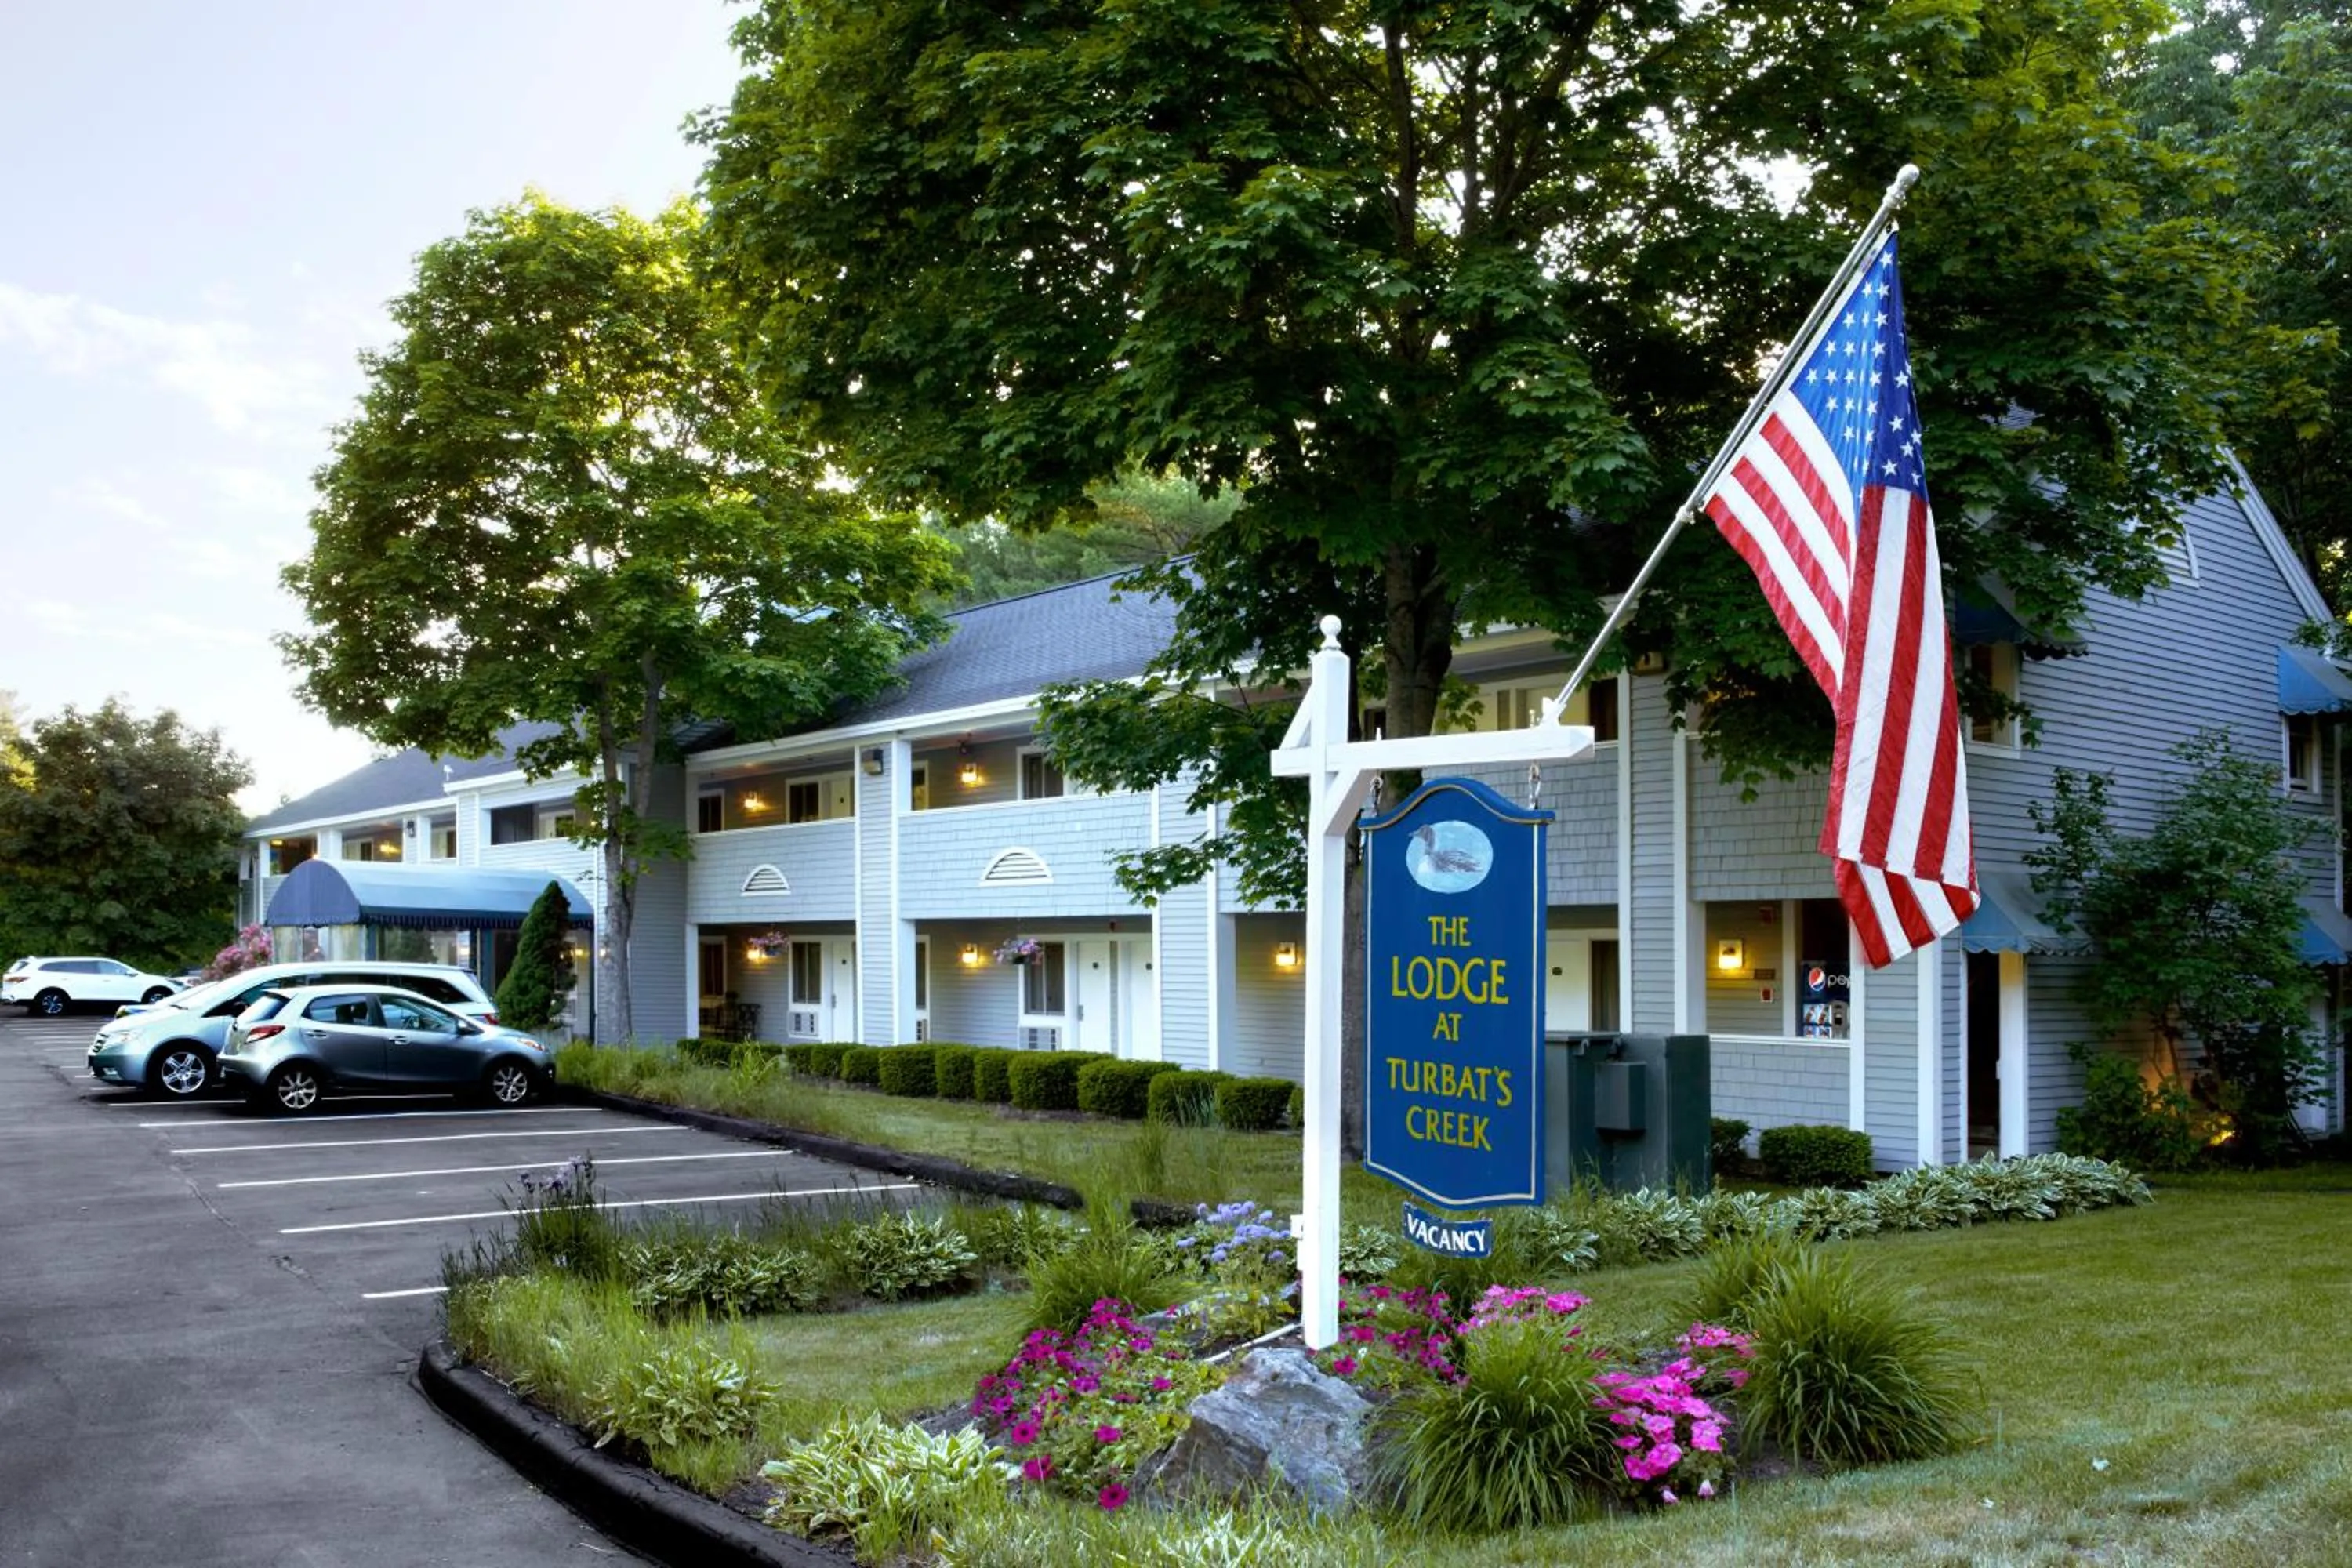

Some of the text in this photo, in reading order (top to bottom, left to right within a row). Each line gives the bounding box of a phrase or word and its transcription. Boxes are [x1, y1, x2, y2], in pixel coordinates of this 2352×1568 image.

[1428, 916, 1471, 946] THE
[1392, 956, 1509, 1004] LODGE
[1432, 1012, 1462, 1041] AT
[1386, 1057, 1512, 1106] TURBAT'S
[1406, 1105, 1492, 1152] CREEK
[1407, 1213, 1485, 1252] VACANCY
